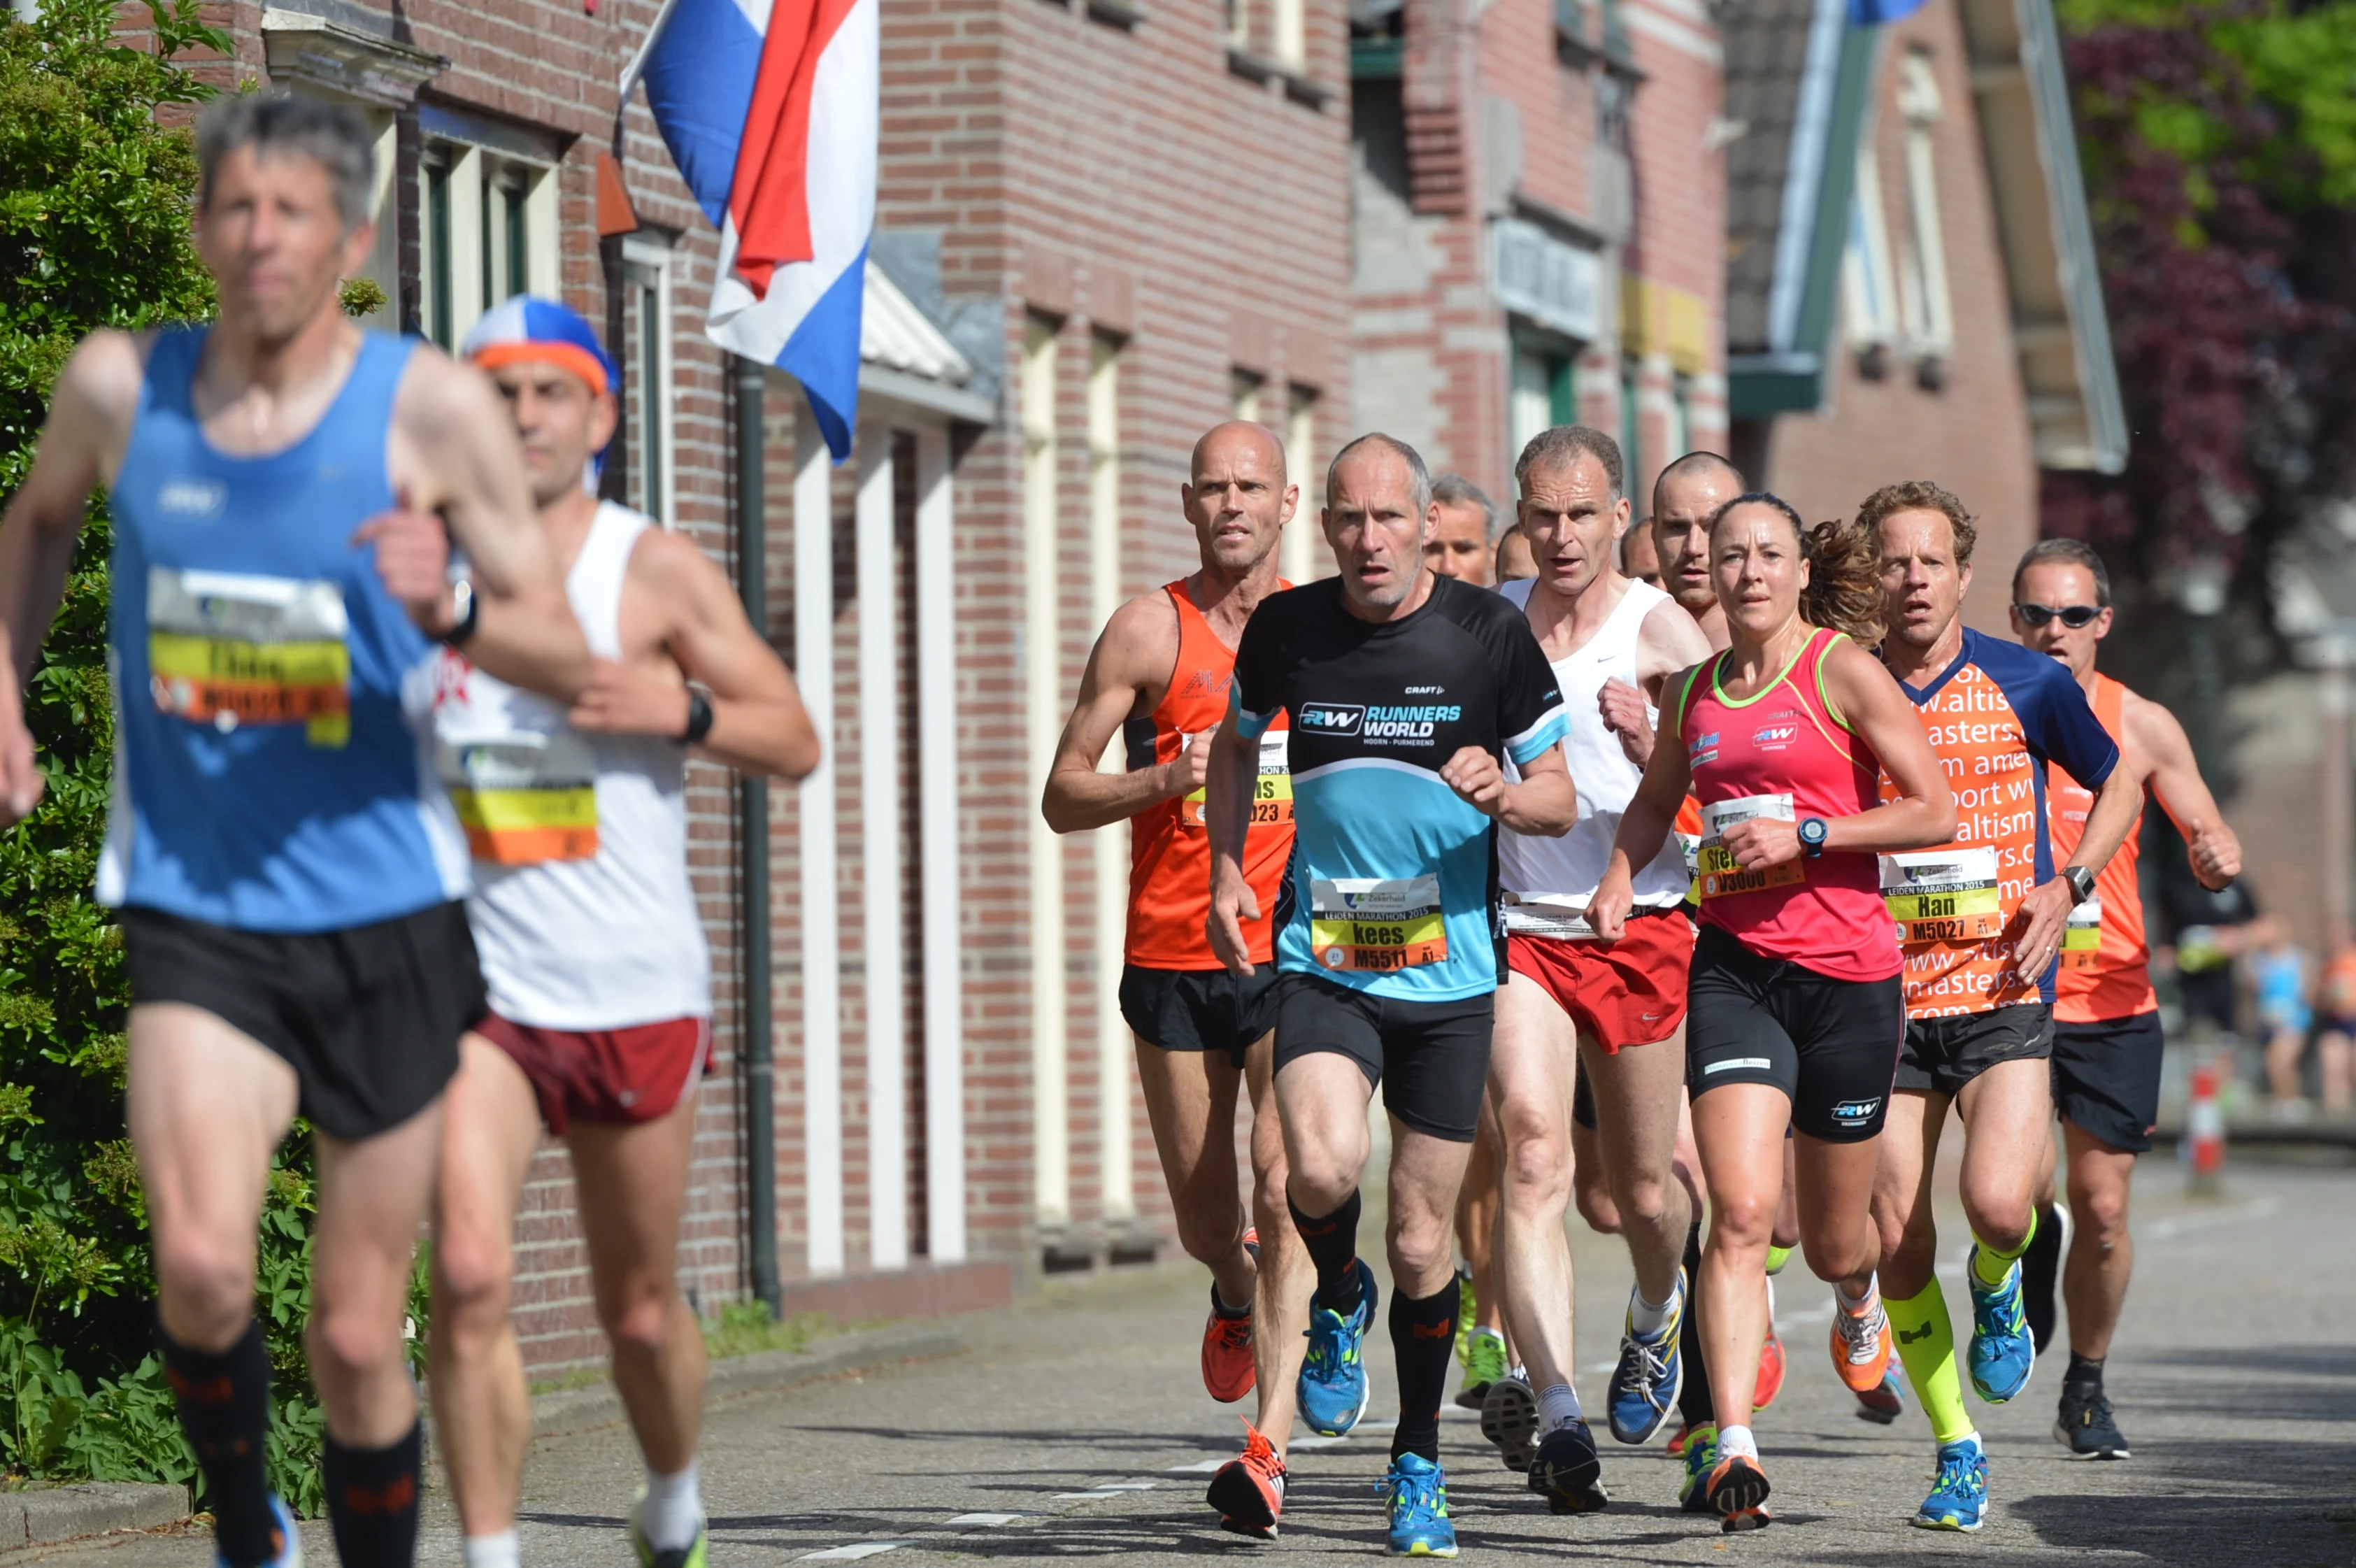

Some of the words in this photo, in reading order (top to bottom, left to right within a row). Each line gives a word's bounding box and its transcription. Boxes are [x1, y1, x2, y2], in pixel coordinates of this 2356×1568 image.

[1405, 686, 1436, 694] CRAFT
[1302, 709, 1359, 727] RW
[1365, 706, 1462, 722] RUNNERS
[1364, 721, 1434, 737] WORLD
[1756, 727, 1794, 741] RW
[1888, 888, 1915, 896] LEIDEN
[1916, 883, 1963, 894] MARATHON
[1964, 881, 1985, 890] 2015
[1325, 911, 1355, 920] LEIDEN
[1357, 911, 1407, 921] MARATHON
[1408, 907, 1429, 919] 2015
[1918, 897, 1955, 918] Han
[1353, 922, 1404, 944] kees
[1913, 920, 1964, 941] M5027
[1354, 949, 1408, 969] M5511
[1422, 951, 1433, 963] A1
[1837, 1102, 1877, 1116] RW
